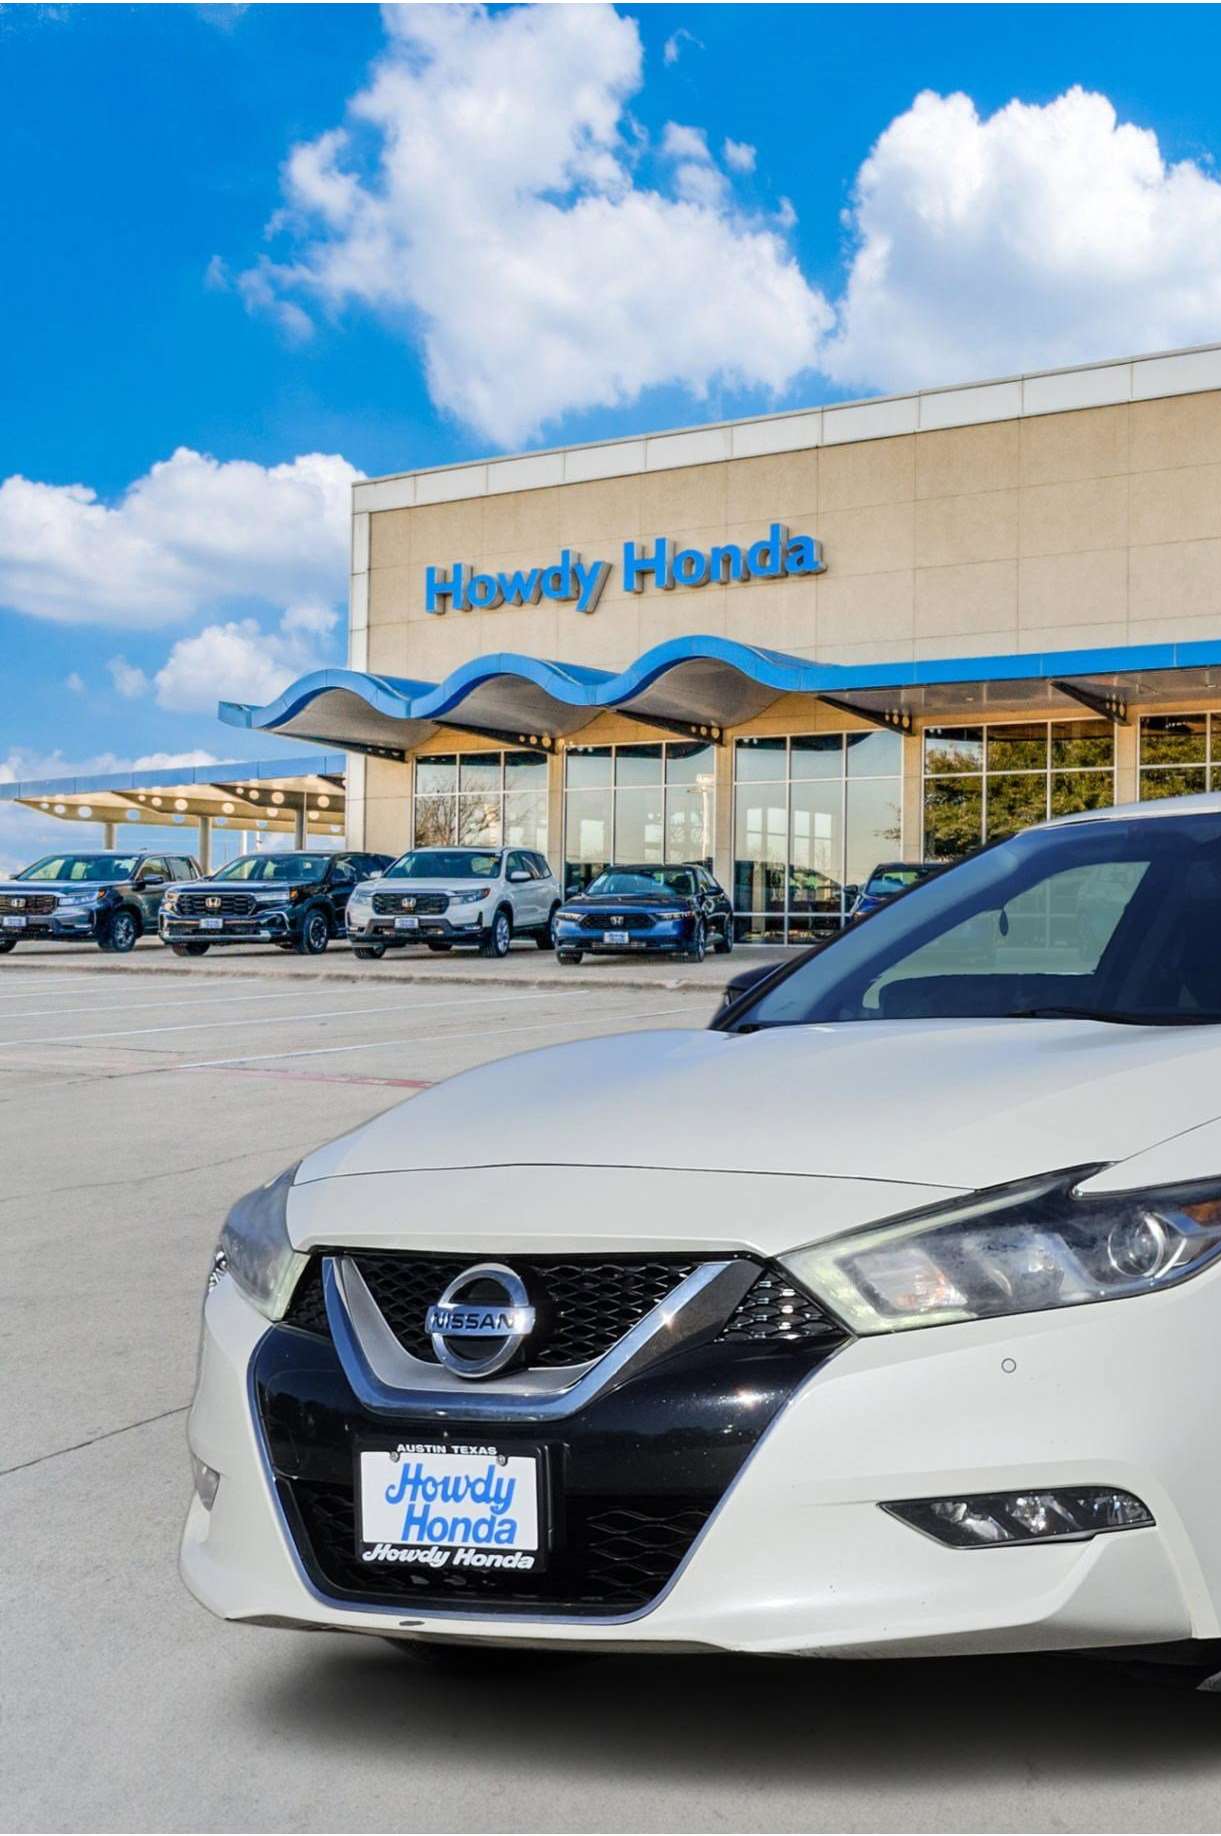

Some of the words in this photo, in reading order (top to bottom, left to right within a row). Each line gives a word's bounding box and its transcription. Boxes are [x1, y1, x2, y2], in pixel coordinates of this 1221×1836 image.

[425, 549, 610, 614] Howdy
[623, 522, 825, 593] Honda
[431, 1312, 514, 1330] NISSAN
[396, 1443, 447, 1455] AUSTIN
[451, 1444, 498, 1456] TEXAS
[384, 1462, 517, 1515] Howdy
[401, 1503, 518, 1545] Honda
[362, 1543, 451, 1568] Howdy
[452, 1548, 535, 1569] Honda
